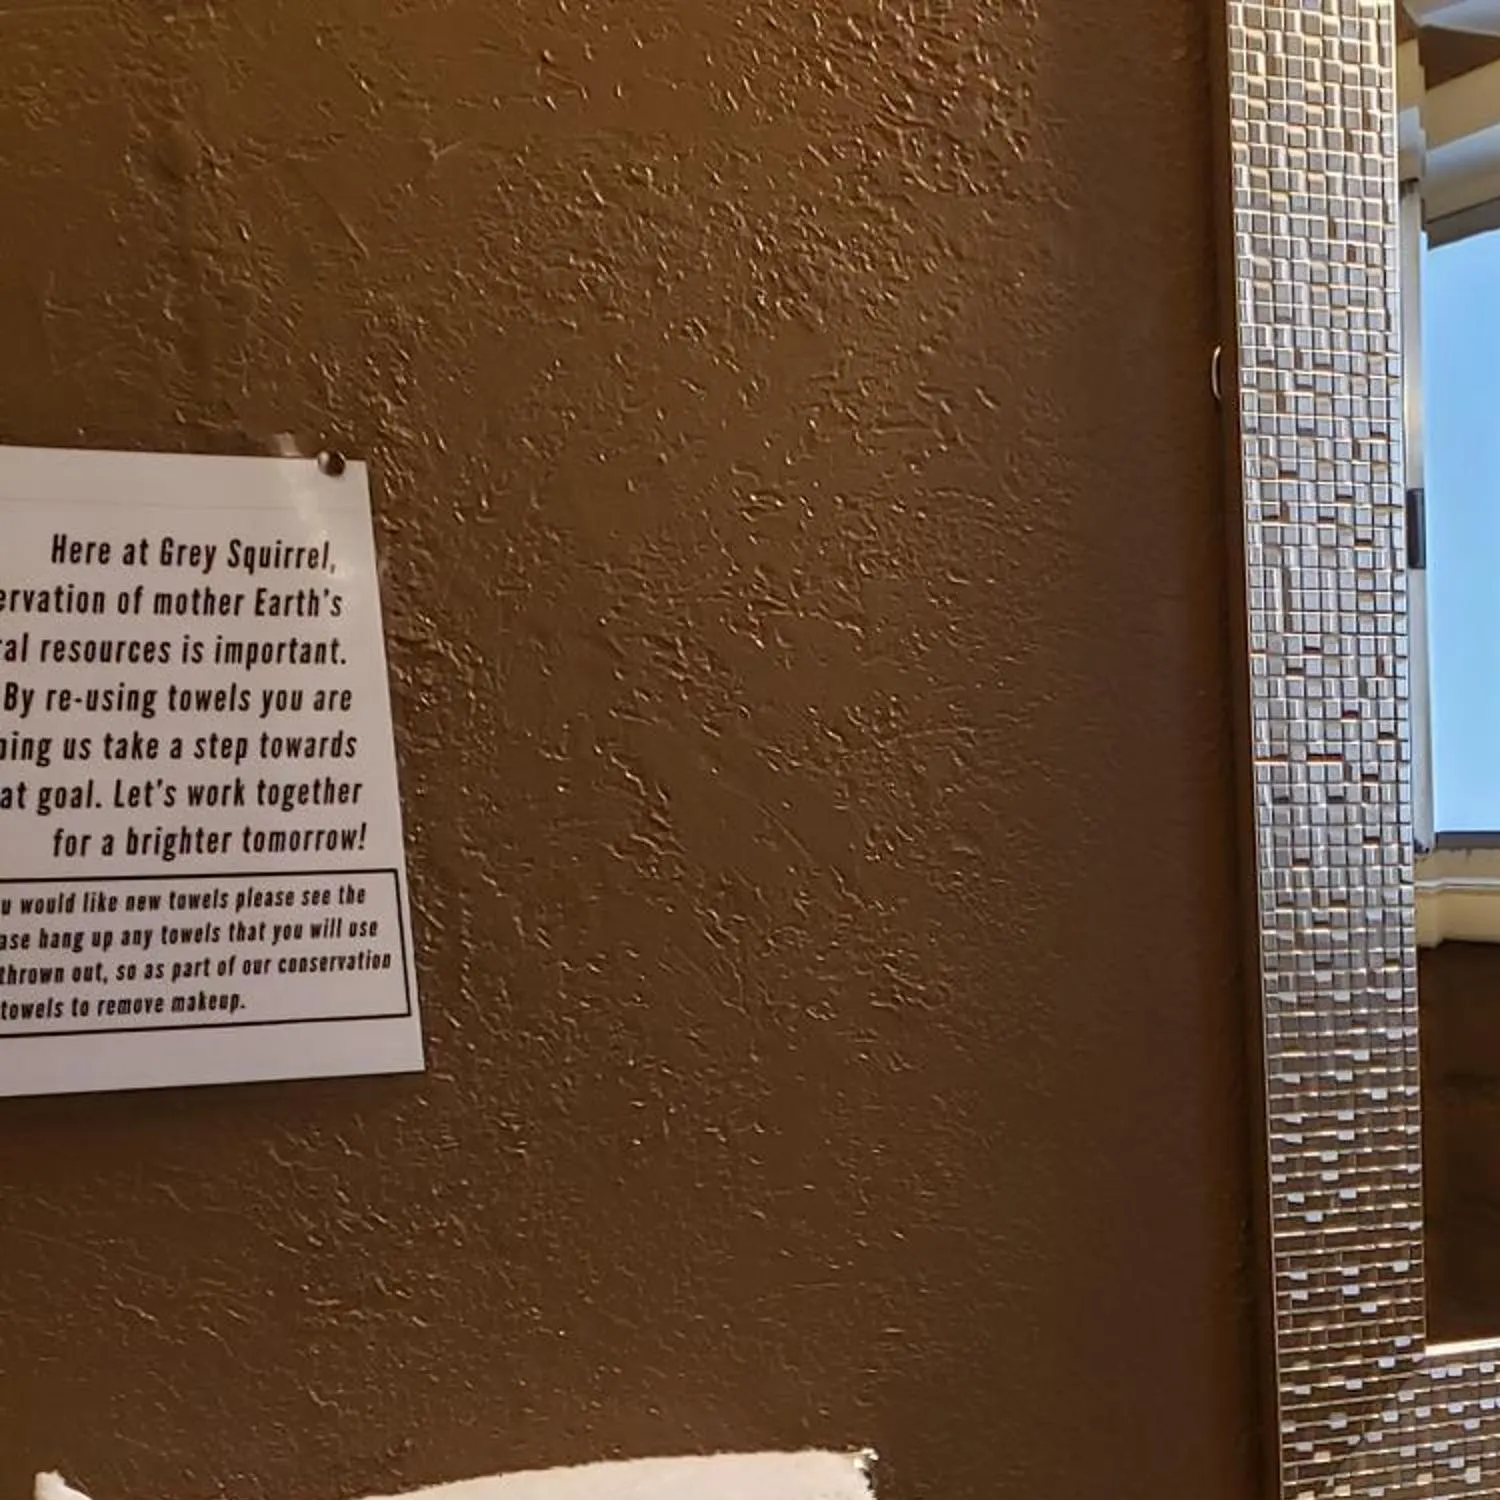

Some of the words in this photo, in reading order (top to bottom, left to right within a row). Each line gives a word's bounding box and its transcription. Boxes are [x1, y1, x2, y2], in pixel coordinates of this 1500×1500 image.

[51, 533, 112, 565] Here
[122, 538, 149, 567] at
[159, 536, 217, 575] Grey
[226, 538, 337, 576] Squirrel,
[117, 584, 144, 615] of
[153, 586, 245, 617] mother
[254, 587, 343, 618] Earth's
[0, 631, 29, 663] al
[39, 639, 172, 664] resources
[181, 634, 205, 665] is
[214, 634, 347, 672] important.
[3, 681, 35, 719] By
[45, 681, 158, 720] re-using
[168, 682, 251, 712] towels
[259, 689, 303, 719] you
[313, 689, 353, 712] are
[63, 737, 92, 761] us
[103, 730, 159, 761] take
[169, 737, 183, 760] a
[193, 732, 249, 766] step
[259, 729, 358, 760] towards
[36, 778, 102, 817] goal.
[113, 778, 177, 809] Let's
[187, 777, 245, 807] work
[256, 776, 363, 813] together
[53, 827, 92, 858] for
[101, 833, 115, 857] a
[125, 825, 233, 863] brighter
[242, 821, 367, 854] tomorrow!
[19, 892, 77, 915] would
[82, 891, 119, 913] like
[125, 895, 162, 913] new
[169, 887, 229, 911] towels
[235, 886, 295, 914] please
[300, 889, 331, 907] see
[338, 883, 366, 905] the
[38, 927, 85, 954] hang
[91, 930, 114, 953] up
[120, 929, 153, 951] any
[161, 921, 221, 945] towels
[228, 920, 267, 943] that
[271, 923, 304, 947] you
[309, 917, 343, 940] will
[348, 920, 378, 938] use
[0, 963, 65, 986] thrown
[71, 961, 109, 985] out,
[115, 963, 137, 982] so
[143, 963, 165, 981] as
[171, 957, 211, 984] part
[216, 955, 237, 977] of
[242, 958, 272, 976] our
[277, 949, 392, 974] conservation
[0, 997, 65, 1021] towels
[71, 997, 90, 1018] to
[97, 996, 165, 1017] remove
[170, 990, 246, 1015] makeup.
